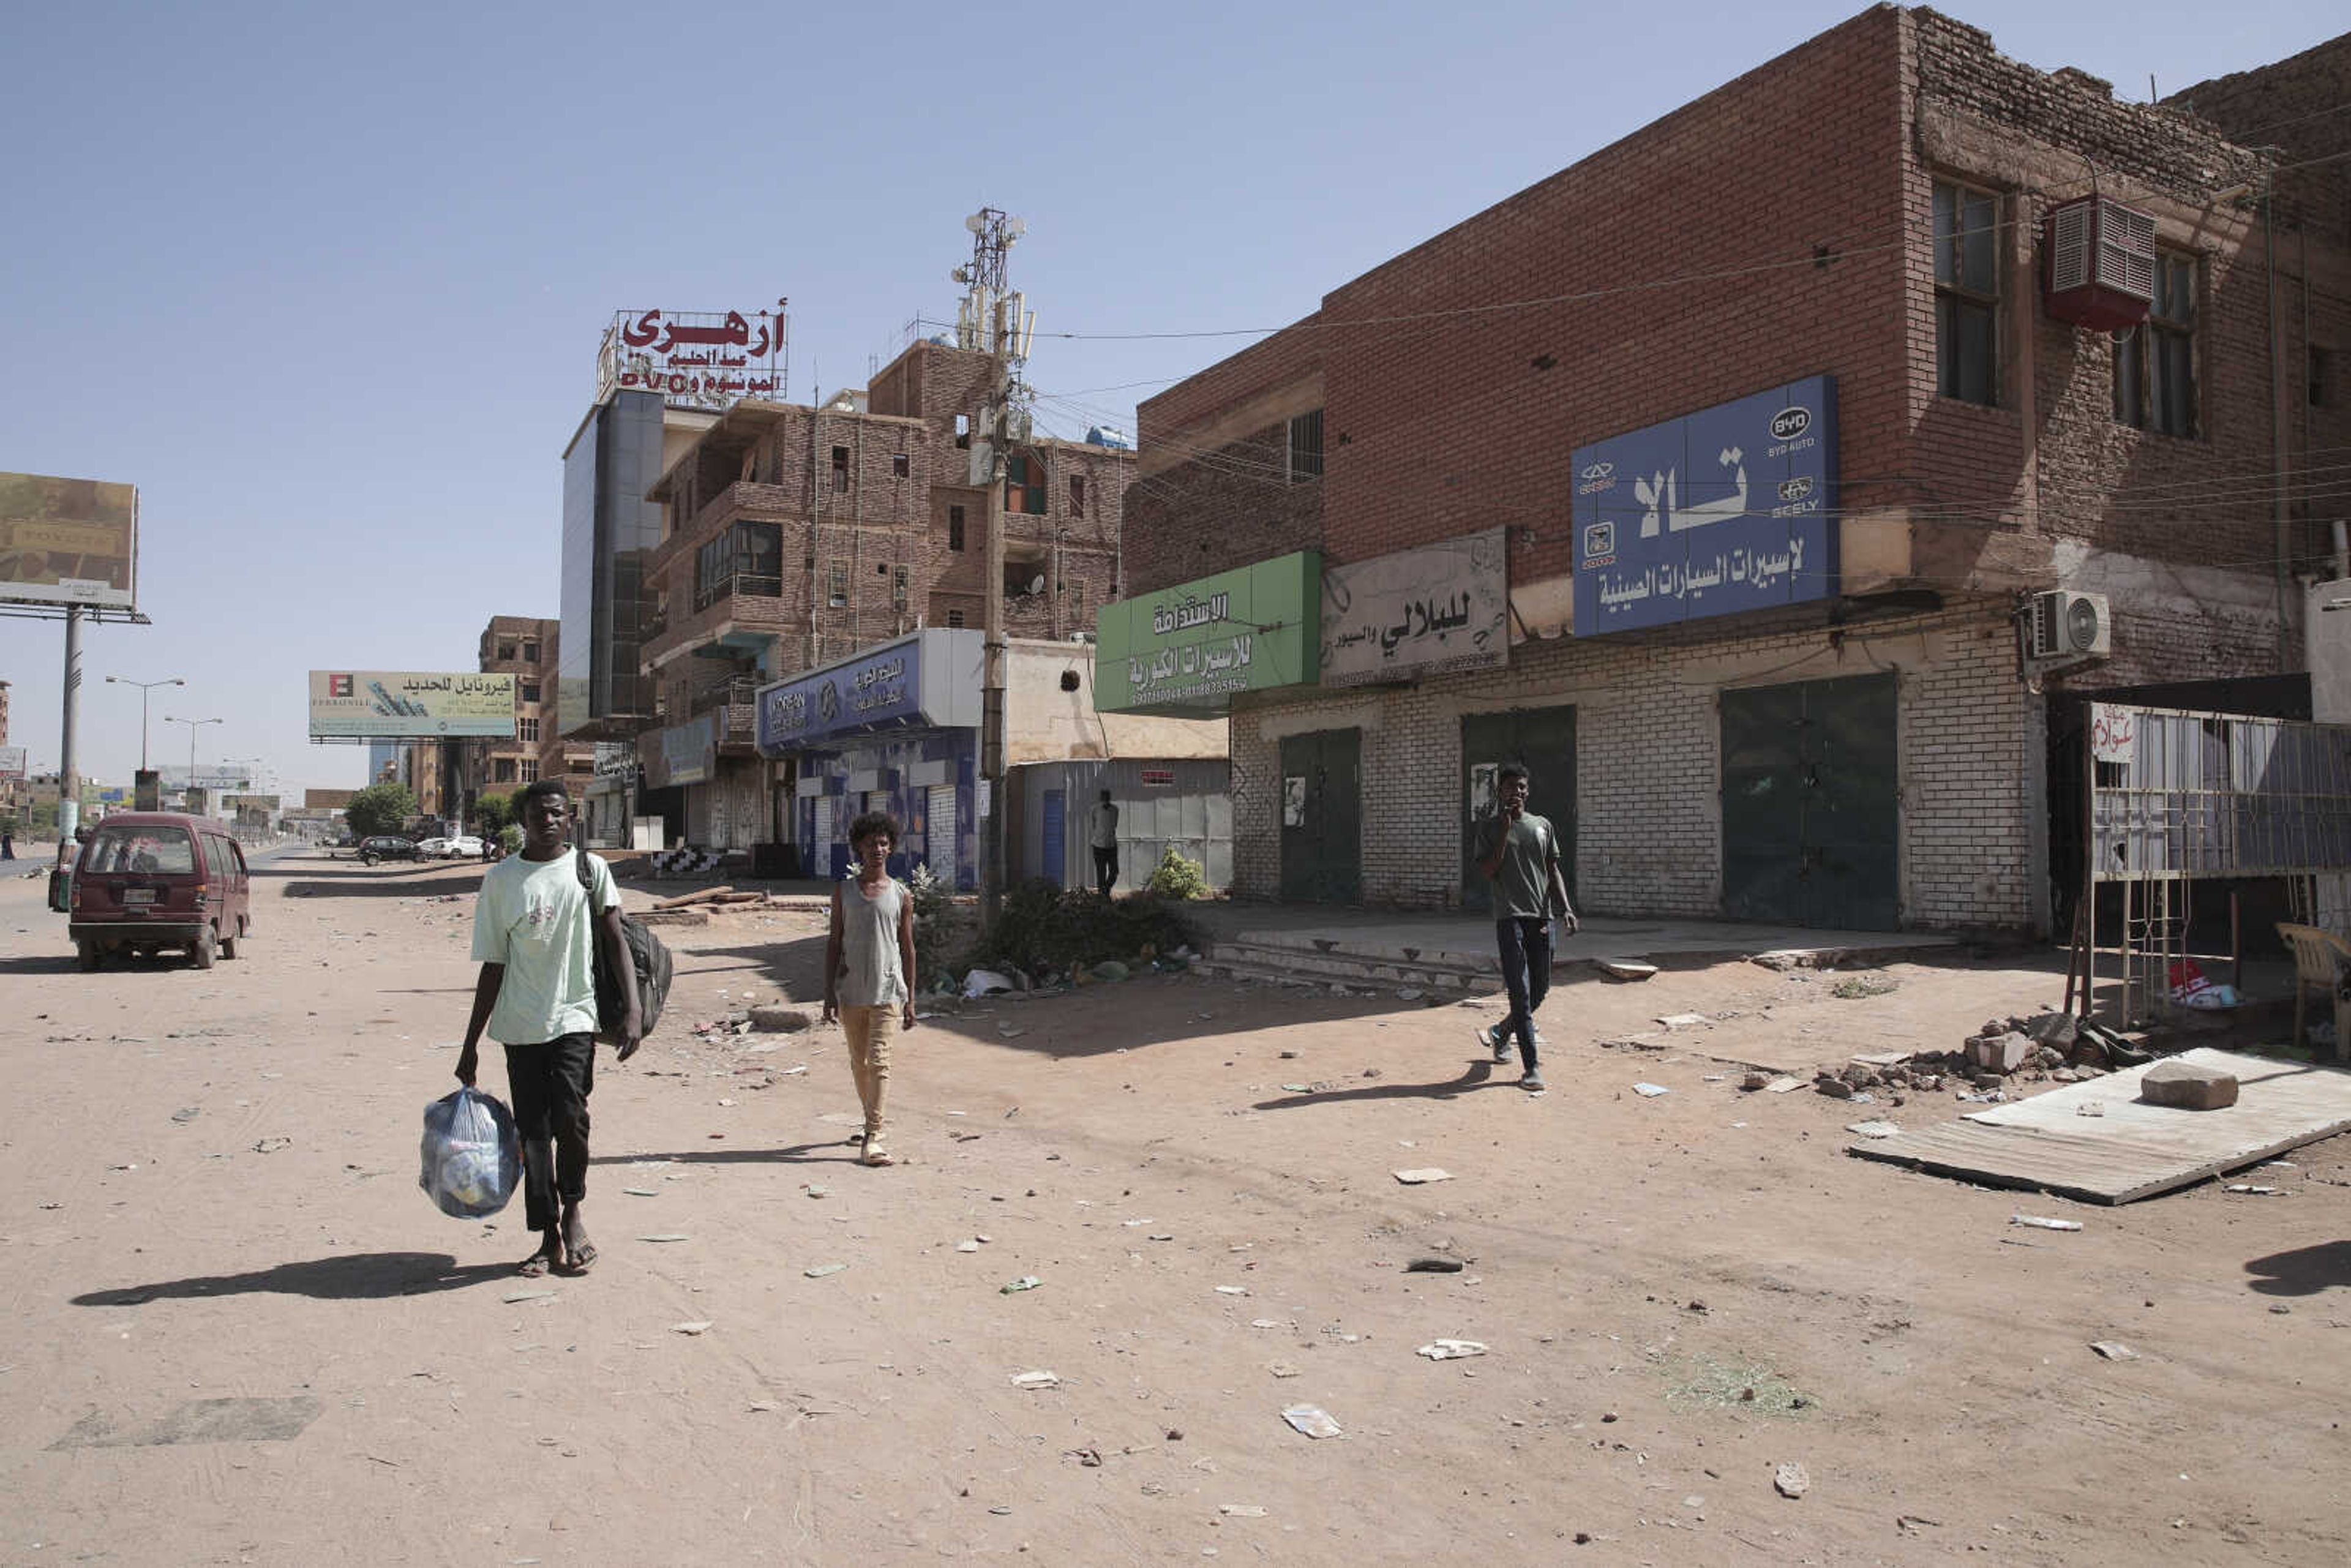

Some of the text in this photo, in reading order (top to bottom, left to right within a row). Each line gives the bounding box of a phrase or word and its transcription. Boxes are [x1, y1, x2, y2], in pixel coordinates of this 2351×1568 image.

[1775, 415, 1805, 433] BYD
[1769, 445, 1787, 457] BYD
[1599, 569, 1656, 612] الصينية
[1659, 554, 1728, 599] السيارات
[1130, 647, 1179, 691] الكورية
[403, 676, 511, 696] فيرونايل للحديد
